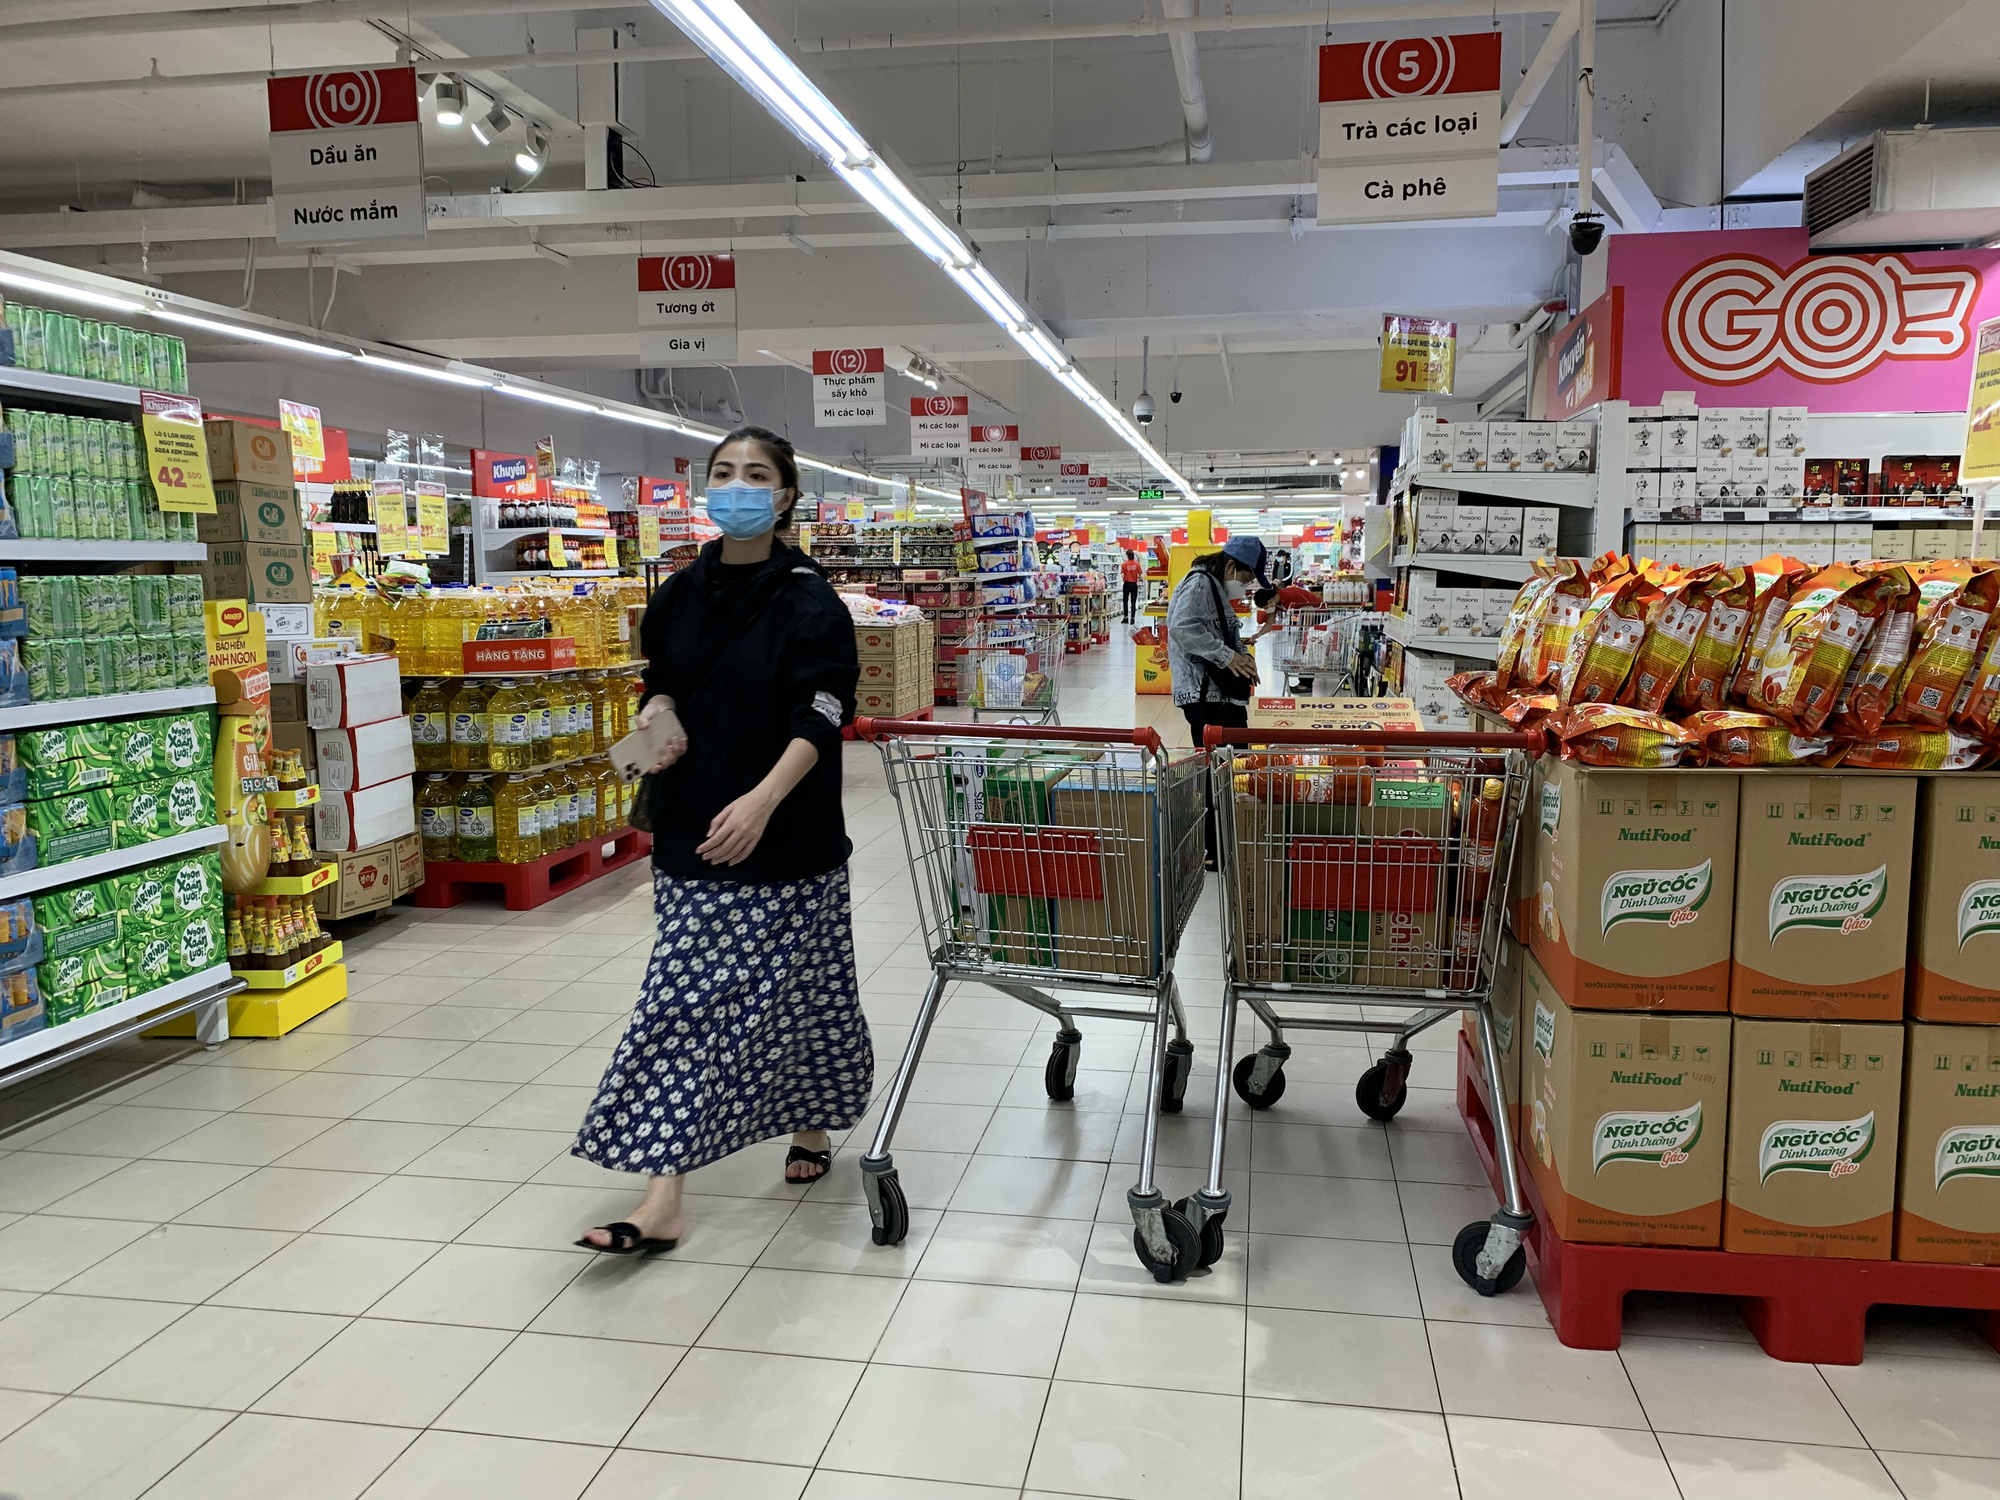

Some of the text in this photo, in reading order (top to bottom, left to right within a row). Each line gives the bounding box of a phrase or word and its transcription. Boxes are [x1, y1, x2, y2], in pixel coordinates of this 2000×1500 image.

[1397, 50, 1420, 82] 5
[325, 82, 361, 113] 10
[1342, 112, 1477, 141] Trà các loại
[310, 144, 377, 166] Dầu ăn
[1364, 177, 1447, 201] Cà phê
[294, 199, 398, 225] Nước mắm
[677, 262, 695, 282] 11
[656, 301, 715, 315] Tương ớt
[669, 338, 705, 352] Gia vị
[840, 354, 857, 369] 12
[1559, 328, 1585, 385] Khuyến
[1395, 359, 1418, 383] 91
[823, 374, 875, 387] Thực phẩm
[831, 387, 868, 399] sấy khô
[824, 406, 874, 418] Mì các loại
[933, 400, 946, 411] 13
[945, 421, 959, 430] loại
[1972, 405, 1992, 433] 22
[988, 428, 1000, 436] 14
[292, 435, 303, 447] 25
[931, 441, 944, 449] các
[946, 441, 960, 449] loại
[1036, 449, 1046, 458] 15
[158, 465, 187, 488] 42
[493, 460, 526, 479] Khuyến
[517, 473, 537, 494] Mãi!
[214, 489, 235, 505] HEO
[653, 485, 675, 500] Khuyến
[223, 551, 242, 567] HEO
[316, 552, 328, 563] 25
[230, 638, 246, 650] HIỂM
[230, 651, 257, 665] NGON
[476, 647, 546, 662] HÀNG TẶNG
[171, 726, 191, 736] Ngon
[38, 731, 68, 759] MIRINDA
[123, 731, 155, 762] MIRINDA
[174, 785, 195, 795] Ngon
[1380, 787, 1409, 796] Tôm
[64, 798, 89, 821] MIRINDA
[128, 794, 158, 825] MIRINDA
[1618, 827, 1692, 842] NutiFood
[1787, 831, 1866, 848] NutiFood
[180, 870, 201, 880] Ngon
[1611, 872, 1699, 900] NGŨ CỐC
[1780, 877, 1873, 905] NGŨ CỐC
[71, 890, 96, 915] MIRINDA
[132, 880, 163, 913] MIRINDA
[1619, 892, 1686, 910] Dinh Dưỡng
[1970, 894, 2000, 910] NG
[1789, 898, 1860, 916] Dinh Dưỡng
[1979, 909, 2000, 921] Din
[1669, 905, 1698, 927] Gấc
[187, 926, 206, 936] Ngon
[1326, 918, 1336, 932] Cay
[1842, 914, 1872, 935] Gấc
[140, 939, 171, 973] MIRINDA
[55, 956, 85, 987] MIRINDA
[1655, 983, 1664, 992] kg
[1825, 990, 1835, 999] kg
[1866, 991, 1881, 999] 500
[1609, 1070, 1683, 1086] NutiFood
[1778, 1078, 1855, 1095] NutiFood
[1603, 1114, 1690, 1139] NGŨ CỐC
[1611, 1134, 1677, 1150] Dinh Dưỡng
[1770, 1125, 1861, 1149] NGŨ CỐC
[1947, 1135, 1995, 1154] NGŨ
[1661, 1148, 1689, 1167] Gấc
[1778, 1144, 1848, 1160] Dinh Dưỡng
[1955, 1153, 1984, 1165] Dinh
[1830, 1159, 1860, 1178] Gấc
